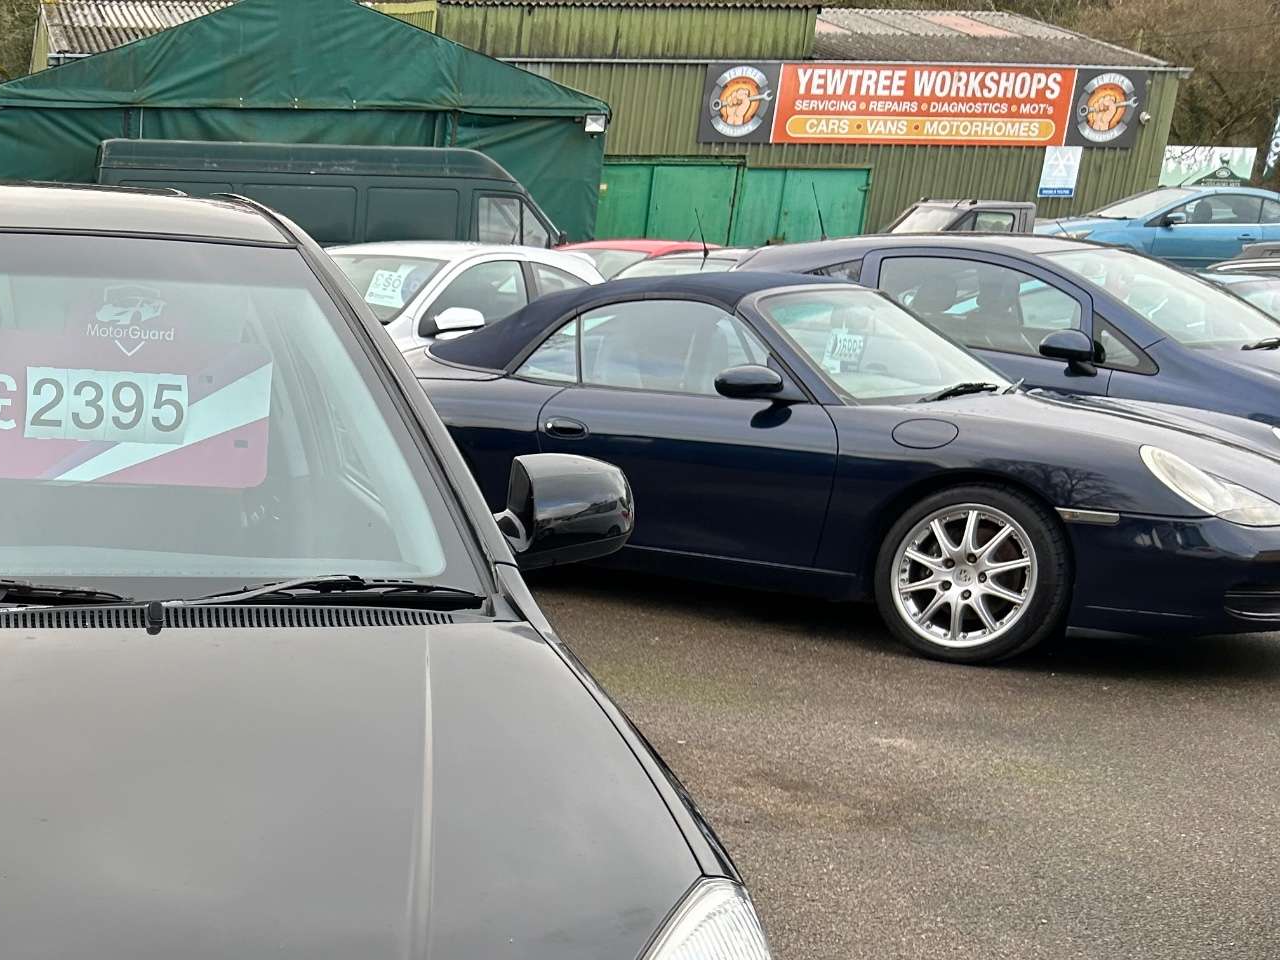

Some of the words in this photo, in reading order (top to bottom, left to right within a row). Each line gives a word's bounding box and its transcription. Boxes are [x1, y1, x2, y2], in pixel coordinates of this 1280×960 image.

[796, 68, 908, 97] YEWTREE
[914, 70, 1063, 100] WORKSHOPS
[794, 99, 857, 112] SERVICING
[869, 101, 918, 113] REPAIRS
[930, 102, 1008, 114] DIAGNOSTICS
[1020, 103, 1054, 115] MOT's
[806, 119, 849, 134] CARS
[866, 120, 908, 134] VANS
[923, 121, 1040, 137] MOTORHOMES
[86, 323, 175, 341] MotorGuard
